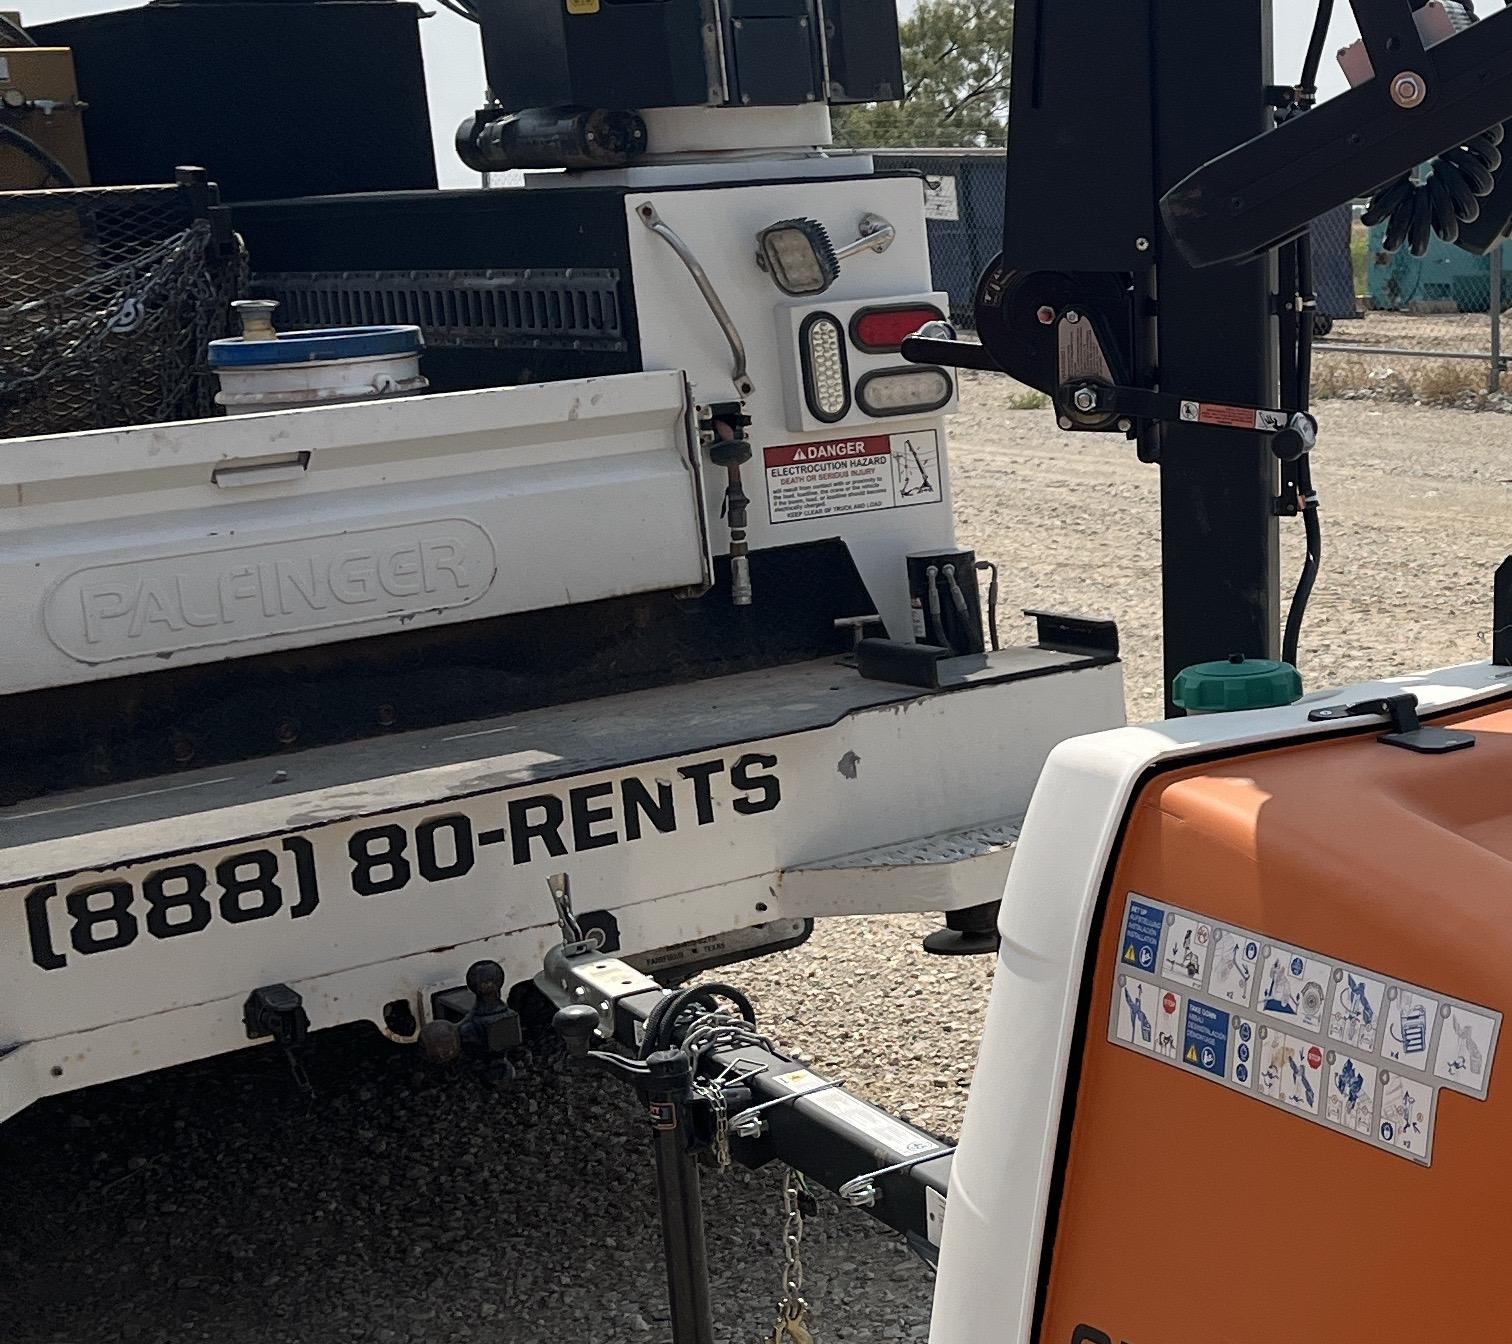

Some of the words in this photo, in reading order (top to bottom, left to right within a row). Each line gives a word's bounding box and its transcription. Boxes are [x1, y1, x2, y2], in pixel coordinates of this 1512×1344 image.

[807, 441, 866, 459] DANGER
[771, 462, 848, 477] ELECTROCUTION
[849, 456, 887, 468] HAZARD
[781, 475, 805, 485] DEATH
[806, 474, 817, 483] OR
[818, 470, 849, 481] SERIOUS
[851, 468, 876, 477] INJURY
[78, 539, 470, 646] PALFINGER
[24, 835, 320, 972] (888)
[347, 752, 781, 897] 80-RENTS
[704, 942, 726, 953] TEXAS
